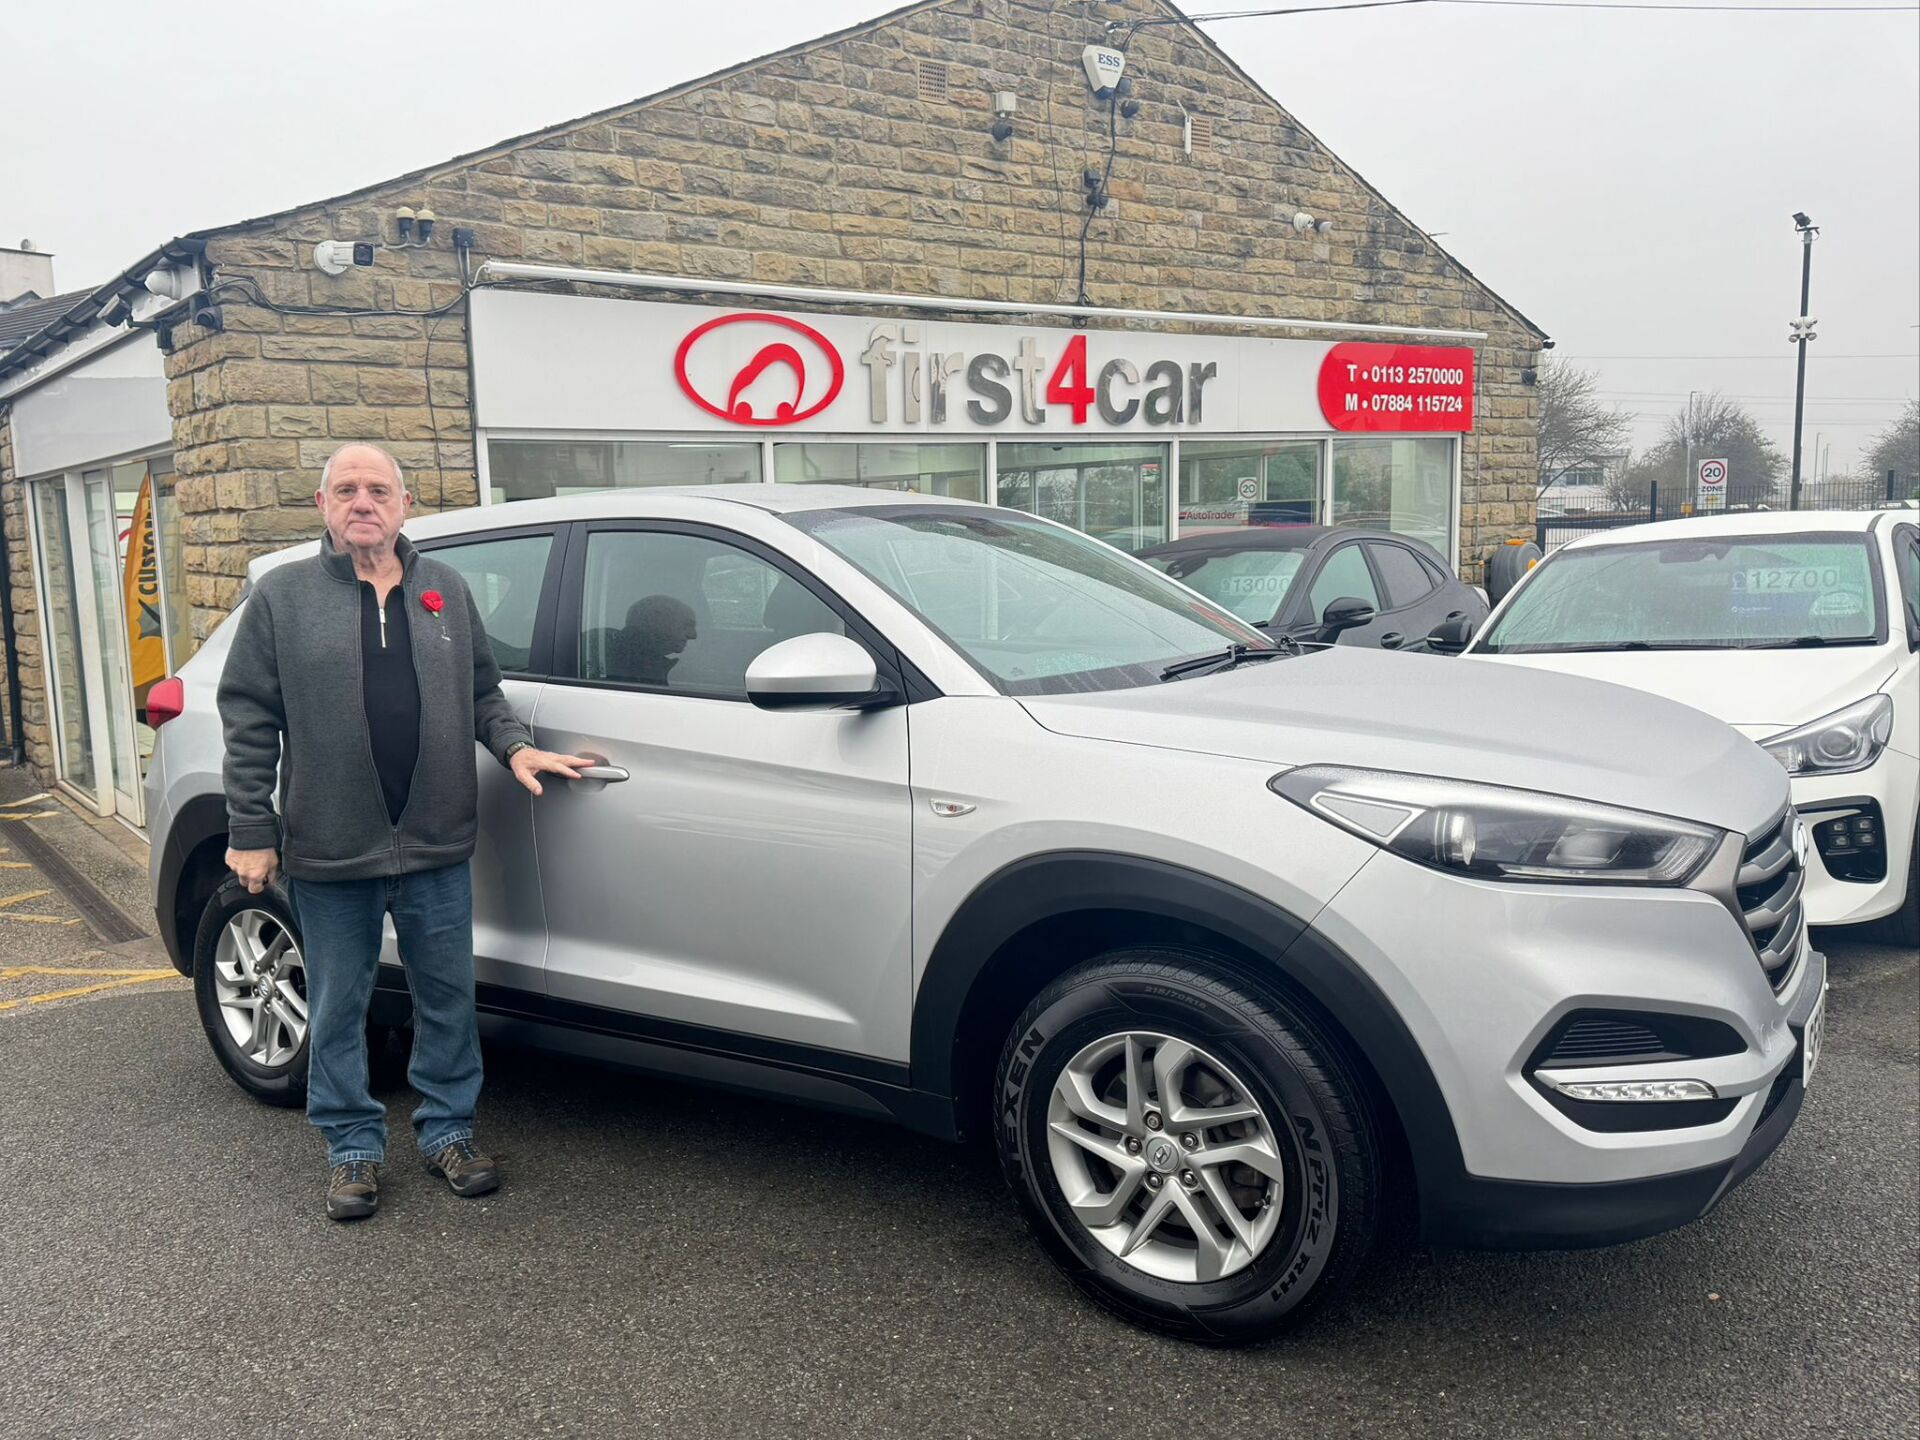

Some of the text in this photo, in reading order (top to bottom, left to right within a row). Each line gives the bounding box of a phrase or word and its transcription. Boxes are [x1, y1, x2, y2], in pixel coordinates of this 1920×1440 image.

[1097, 53, 1121, 68] ESS
[861, 324, 1217, 426] first4car
[1347, 364, 1464, 385] T 0113 2570000
[1345, 393, 1463, 412] M 07884 115724
[1704, 467, 1722, 478] 20
[1242, 483, 1256, 494] 20
[1701, 485, 1724, 493] ZONE
[1186, 509, 1237, 520] AutoTrader
